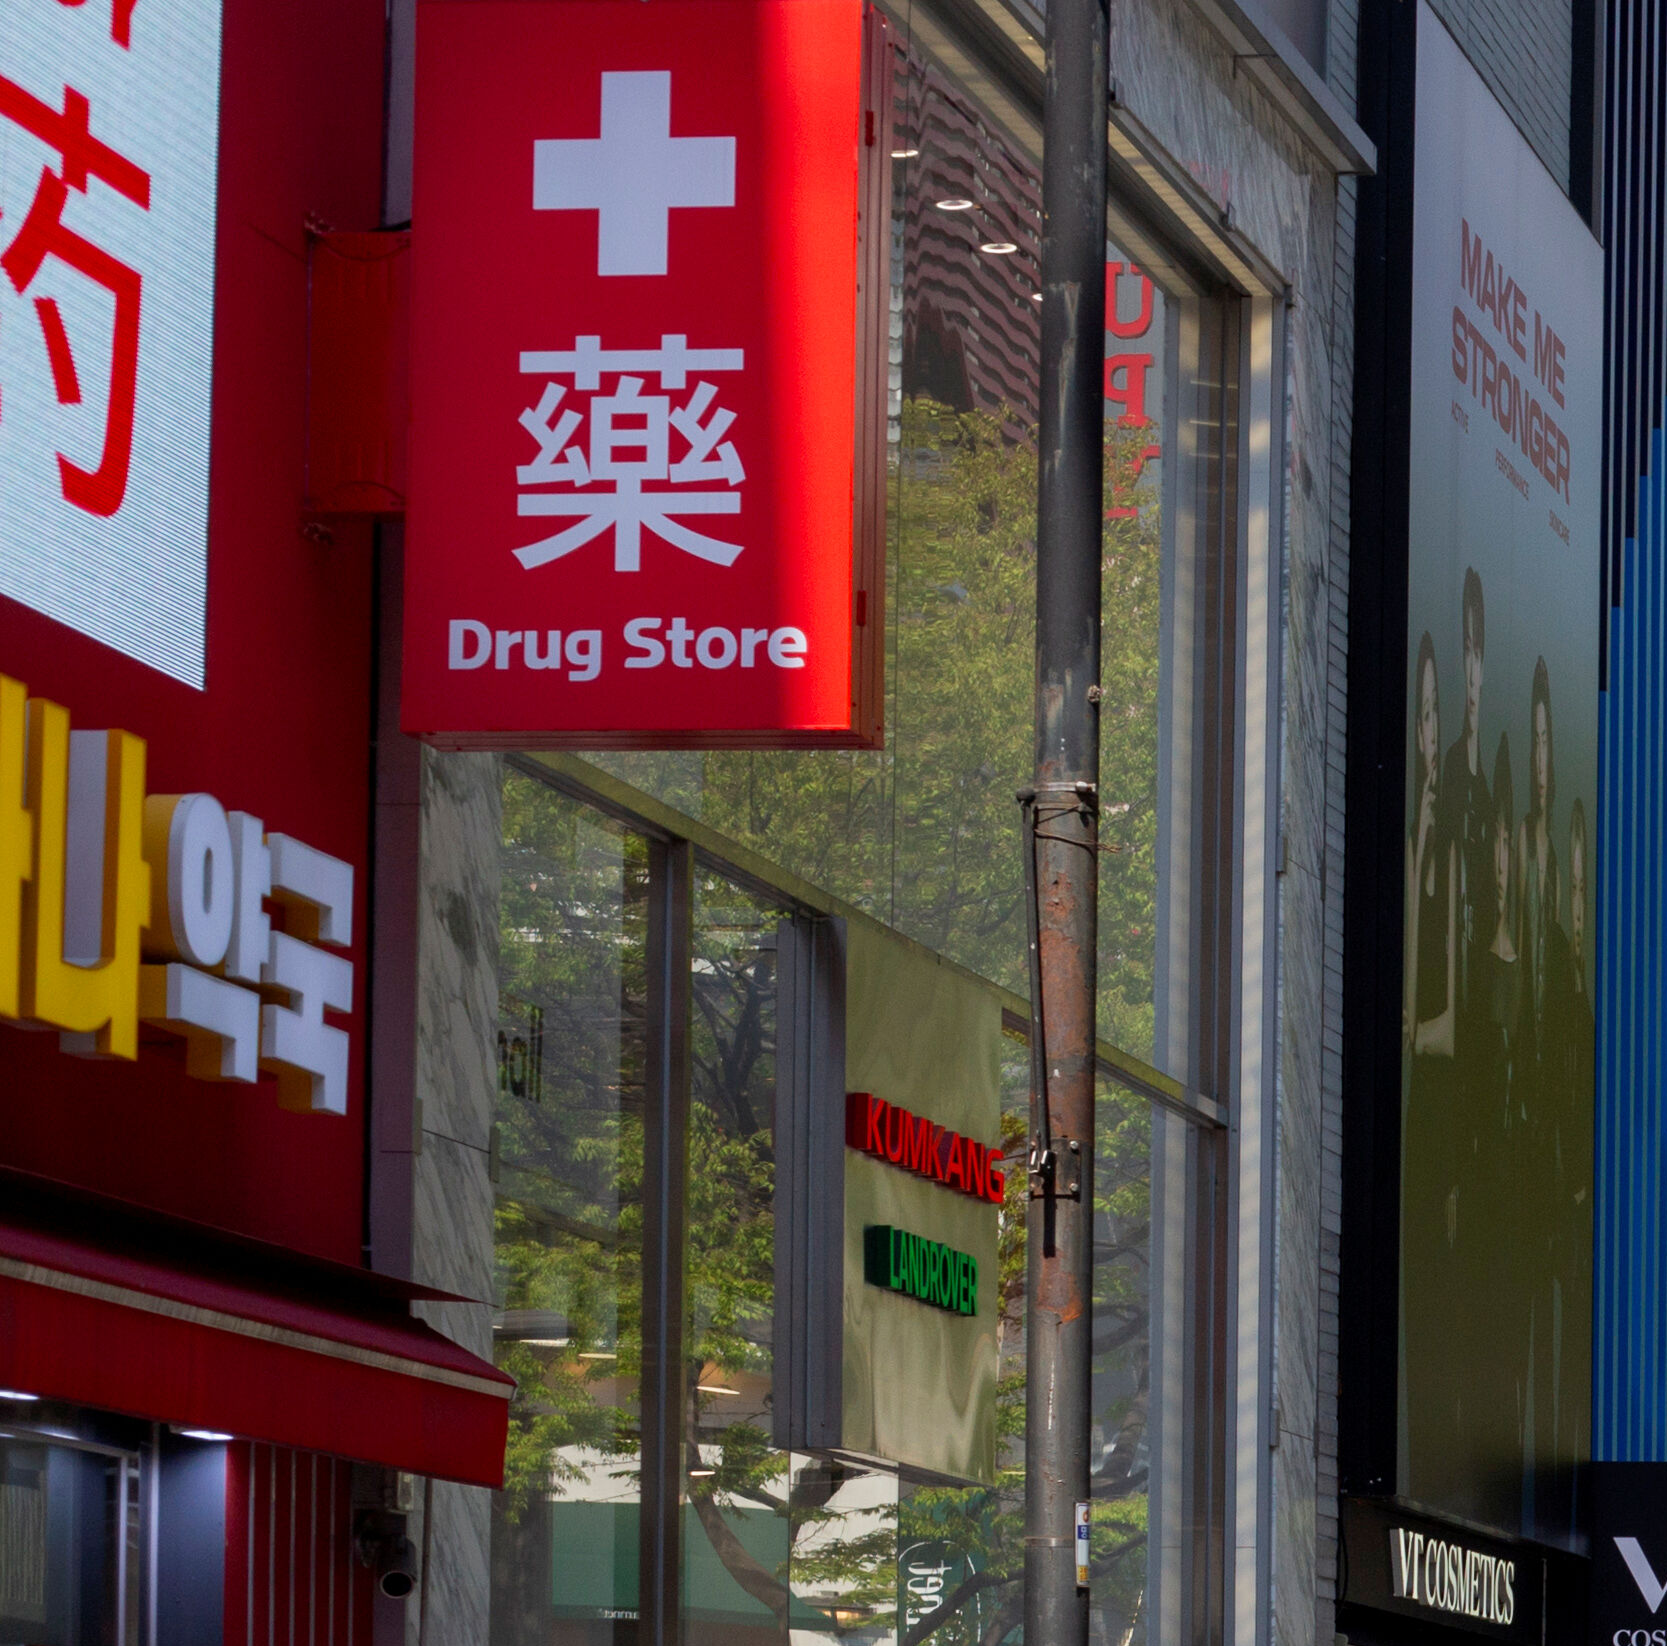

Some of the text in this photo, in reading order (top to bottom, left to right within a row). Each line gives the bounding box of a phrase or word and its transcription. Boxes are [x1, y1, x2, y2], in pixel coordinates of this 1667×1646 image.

[1461, 216, 1567, 411] MAKE ME
[511, 335, 745, 572] 藥
[1452, 305, 1570, 506] STRONGER
[448, 617, 808, 682] Drug Store
[0, 672, 355, 1117] 나약국
[864, 1094, 1004, 1203] KUMKANG
[888, 1226, 979, 1316] LANDROVER
[1398, 1527, 1515, 1626] VT COSMETICS
